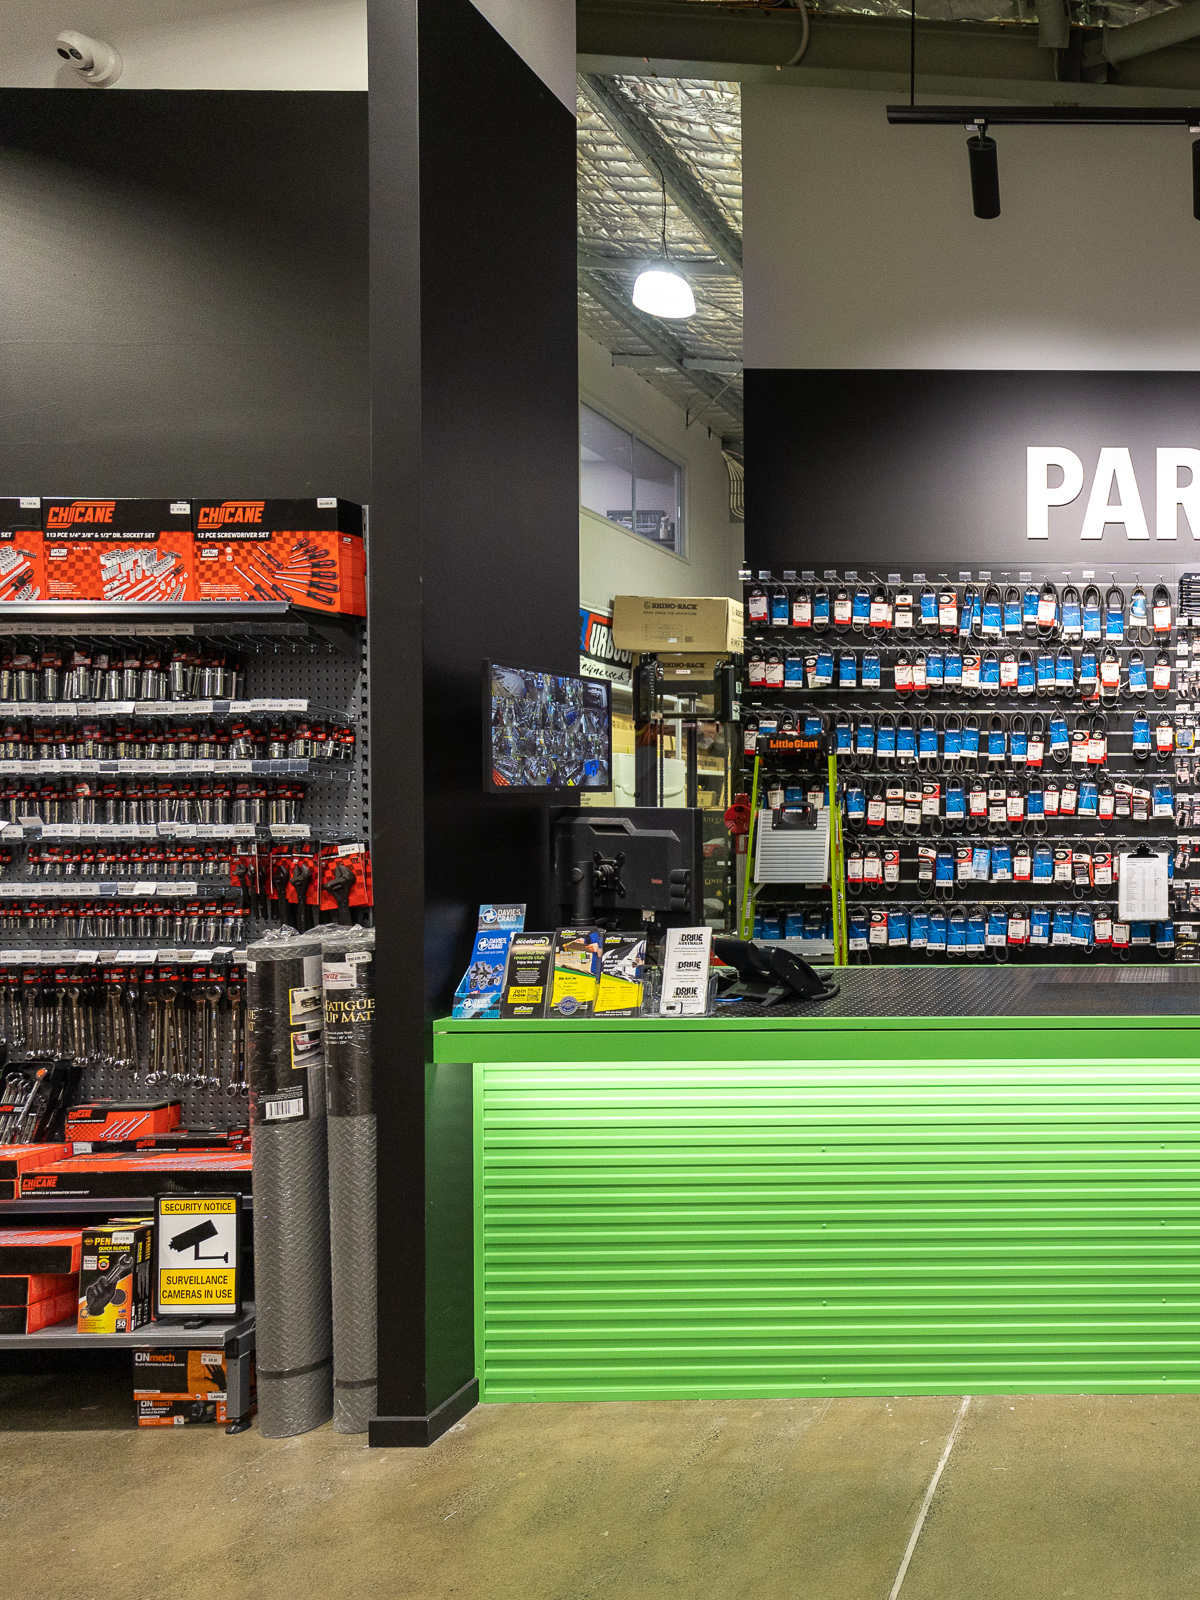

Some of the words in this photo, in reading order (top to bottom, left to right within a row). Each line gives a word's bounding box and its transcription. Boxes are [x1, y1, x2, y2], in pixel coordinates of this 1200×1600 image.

[47, 503, 116, 527] CHICANE
[198, 503, 265, 527] CHICANE
[651, 602, 698, 610] RHINO-RACK
[769, 739, 794, 748] Little
[794, 739, 818, 748] Giant
[516, 937, 546, 945] accelerate
[325, 998, 376, 1011] FATIGUE
[341, 1010, 375, 1023] MAT
[68, 1110, 93, 1119] CHICANE
[22, 1176, 58, 1190] CHICANE
[165, 1203, 202, 1211] SECURITY
[203, 1202, 232, 1211] NOTICE
[166, 1276, 228, 1285] SURVEILLANCE
[162, 1290, 203, 1299] CAMERAS
[204, 1290, 213, 1298] IN
[215, 1289, 233, 1298] USE
[135, 1352, 175, 1362] ONmech
